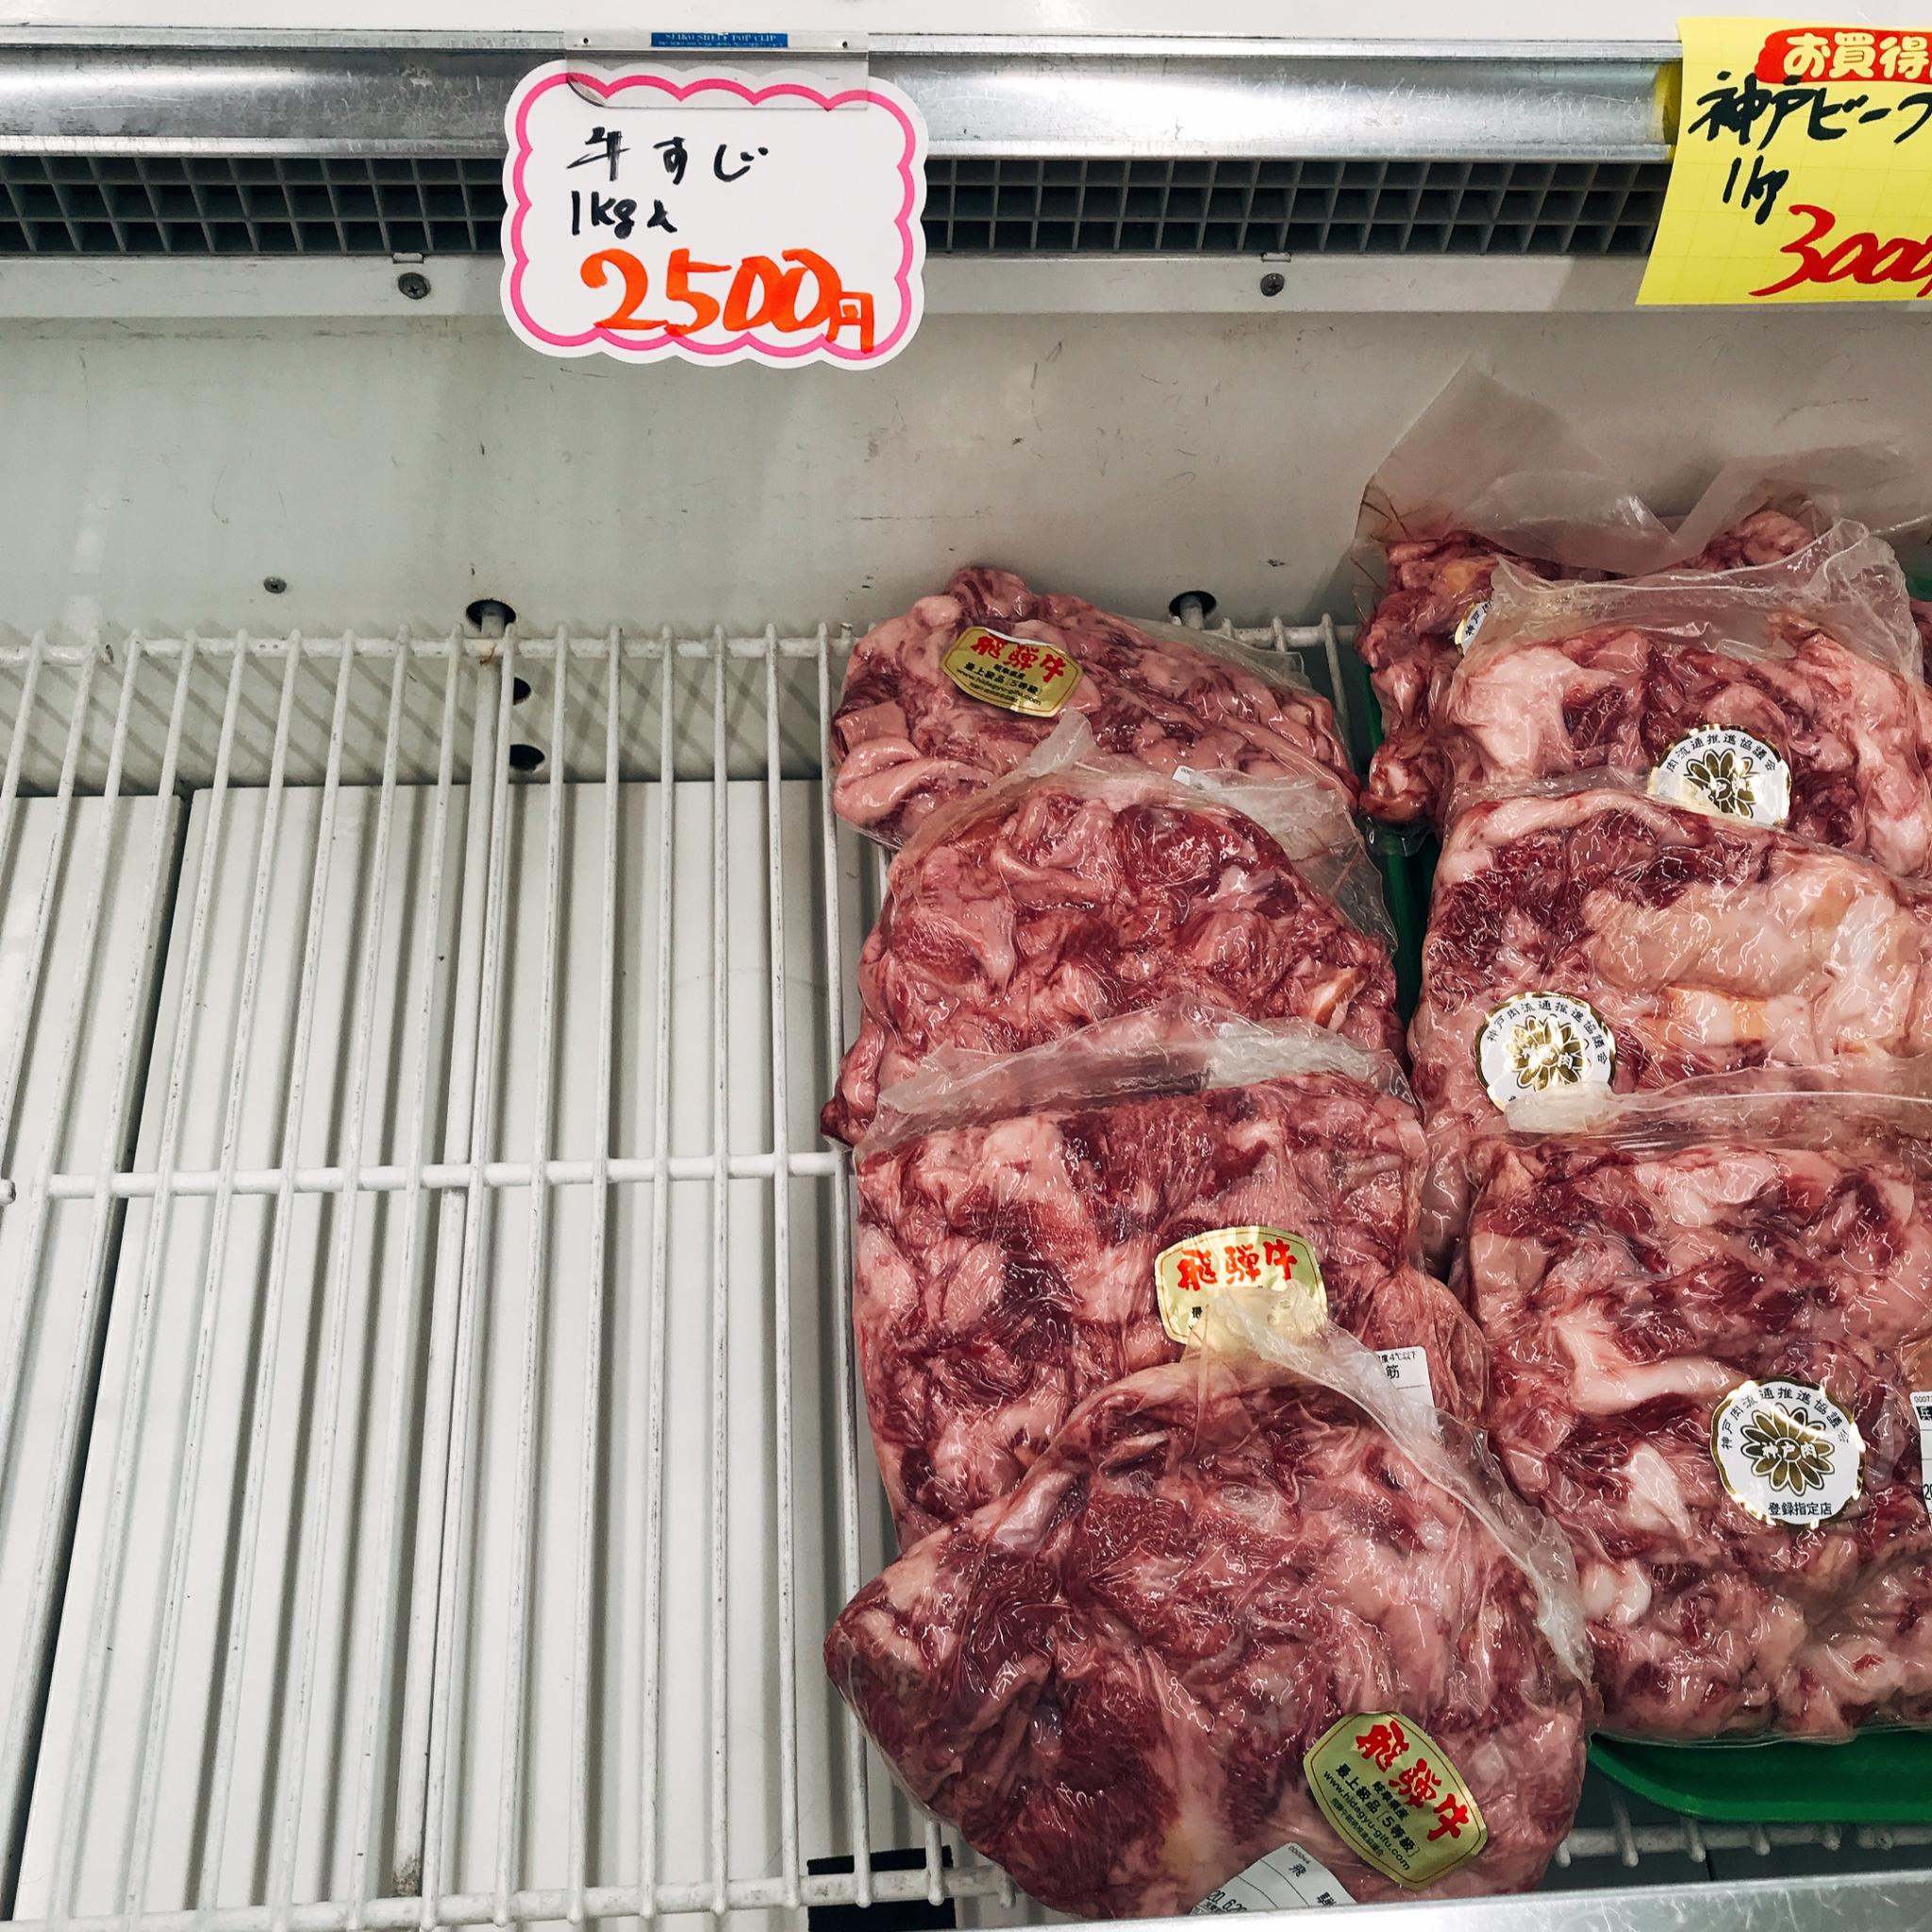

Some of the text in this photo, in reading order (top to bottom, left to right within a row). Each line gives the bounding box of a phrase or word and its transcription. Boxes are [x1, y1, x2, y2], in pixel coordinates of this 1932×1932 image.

[664, 33, 695, 42] SEIKO
[754, 35, 776, 43] CLIP
[1783, 32, 1932, 79] お買得
[1688, 72, 1932, 151] 神戸ビーフ
[566, 125, 770, 185] 牛すじ
[1723, 155, 1790, 225] 1kg
[1748, 204, 1932, 298] 3000
[579, 247, 875, 355] 2500円
[1177, 1238, 1298, 1291] 飛騨牛
[1768, 1502, 1833, 1517] 登録指定店
[1356, 1720, 1470, 1841] 飛騨牛
[1324, 1771, 1411, 1871] www.hidagyu-gifu.com
